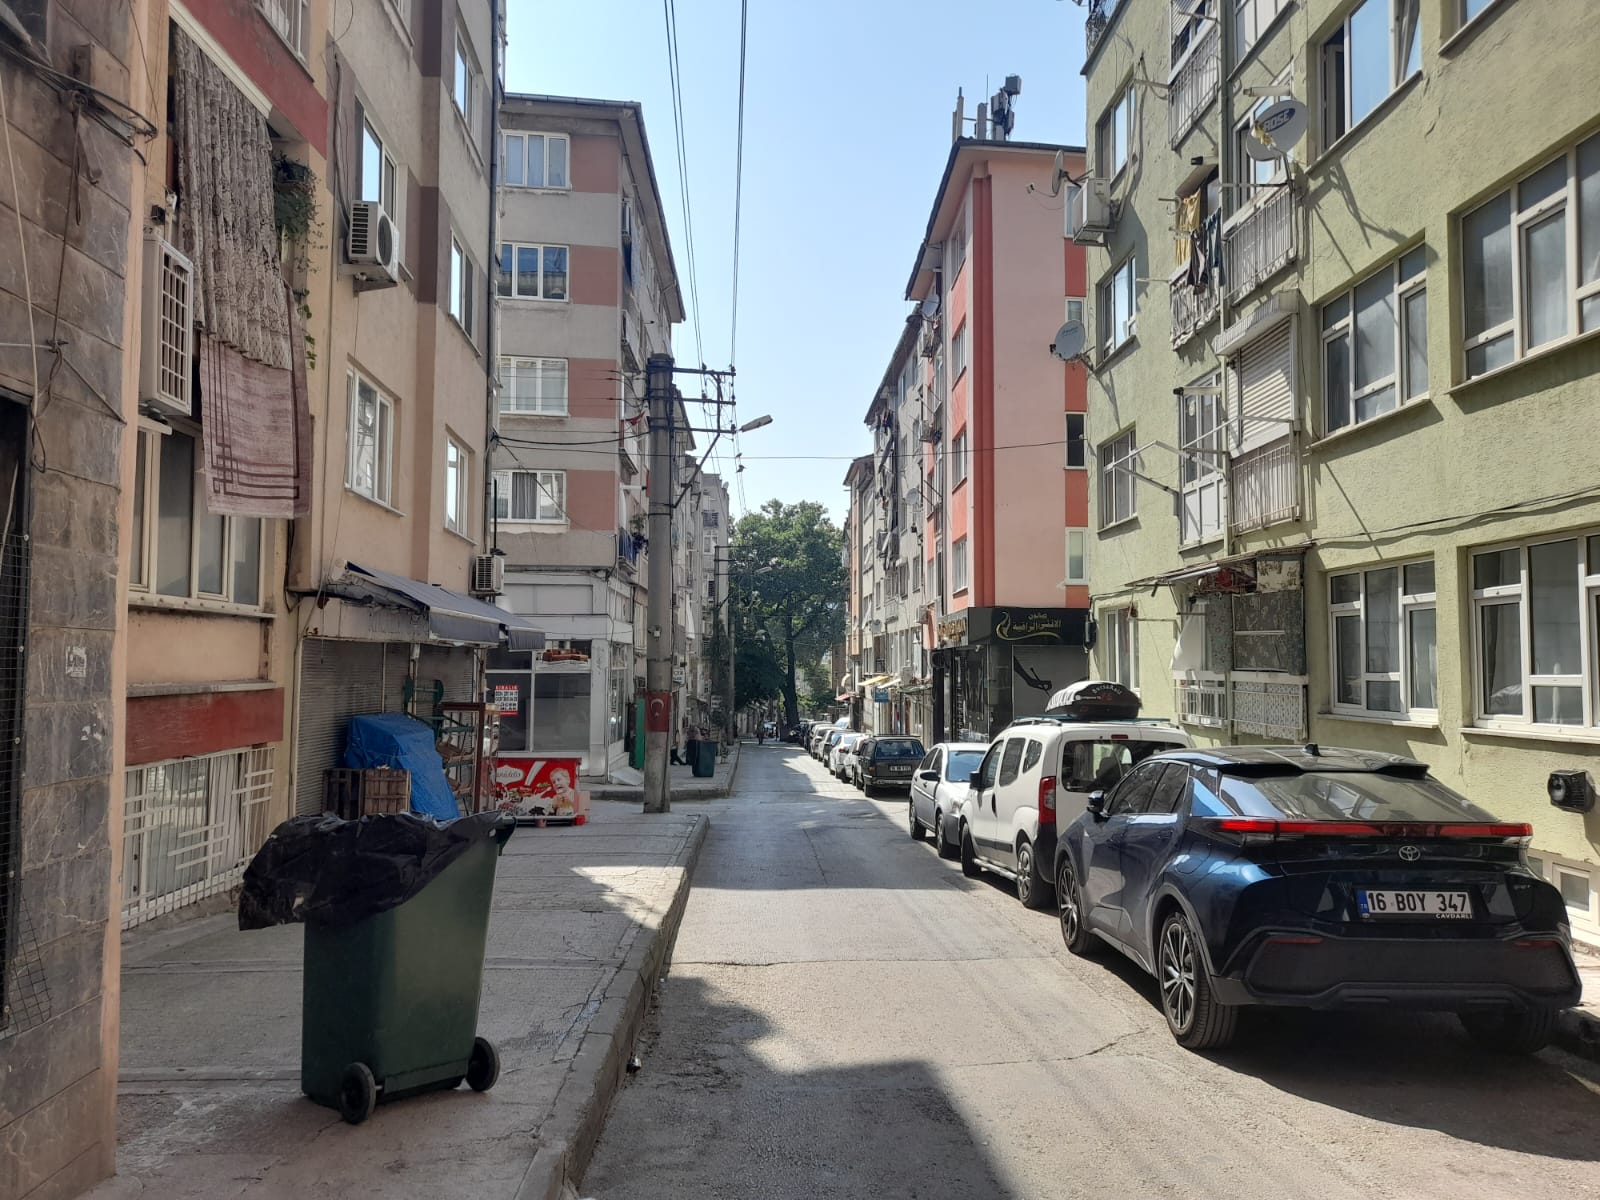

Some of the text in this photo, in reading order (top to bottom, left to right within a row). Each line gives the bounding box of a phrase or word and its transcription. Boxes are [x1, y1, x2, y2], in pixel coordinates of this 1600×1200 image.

[1368, 892, 1467, 912] 16 BOY 347
